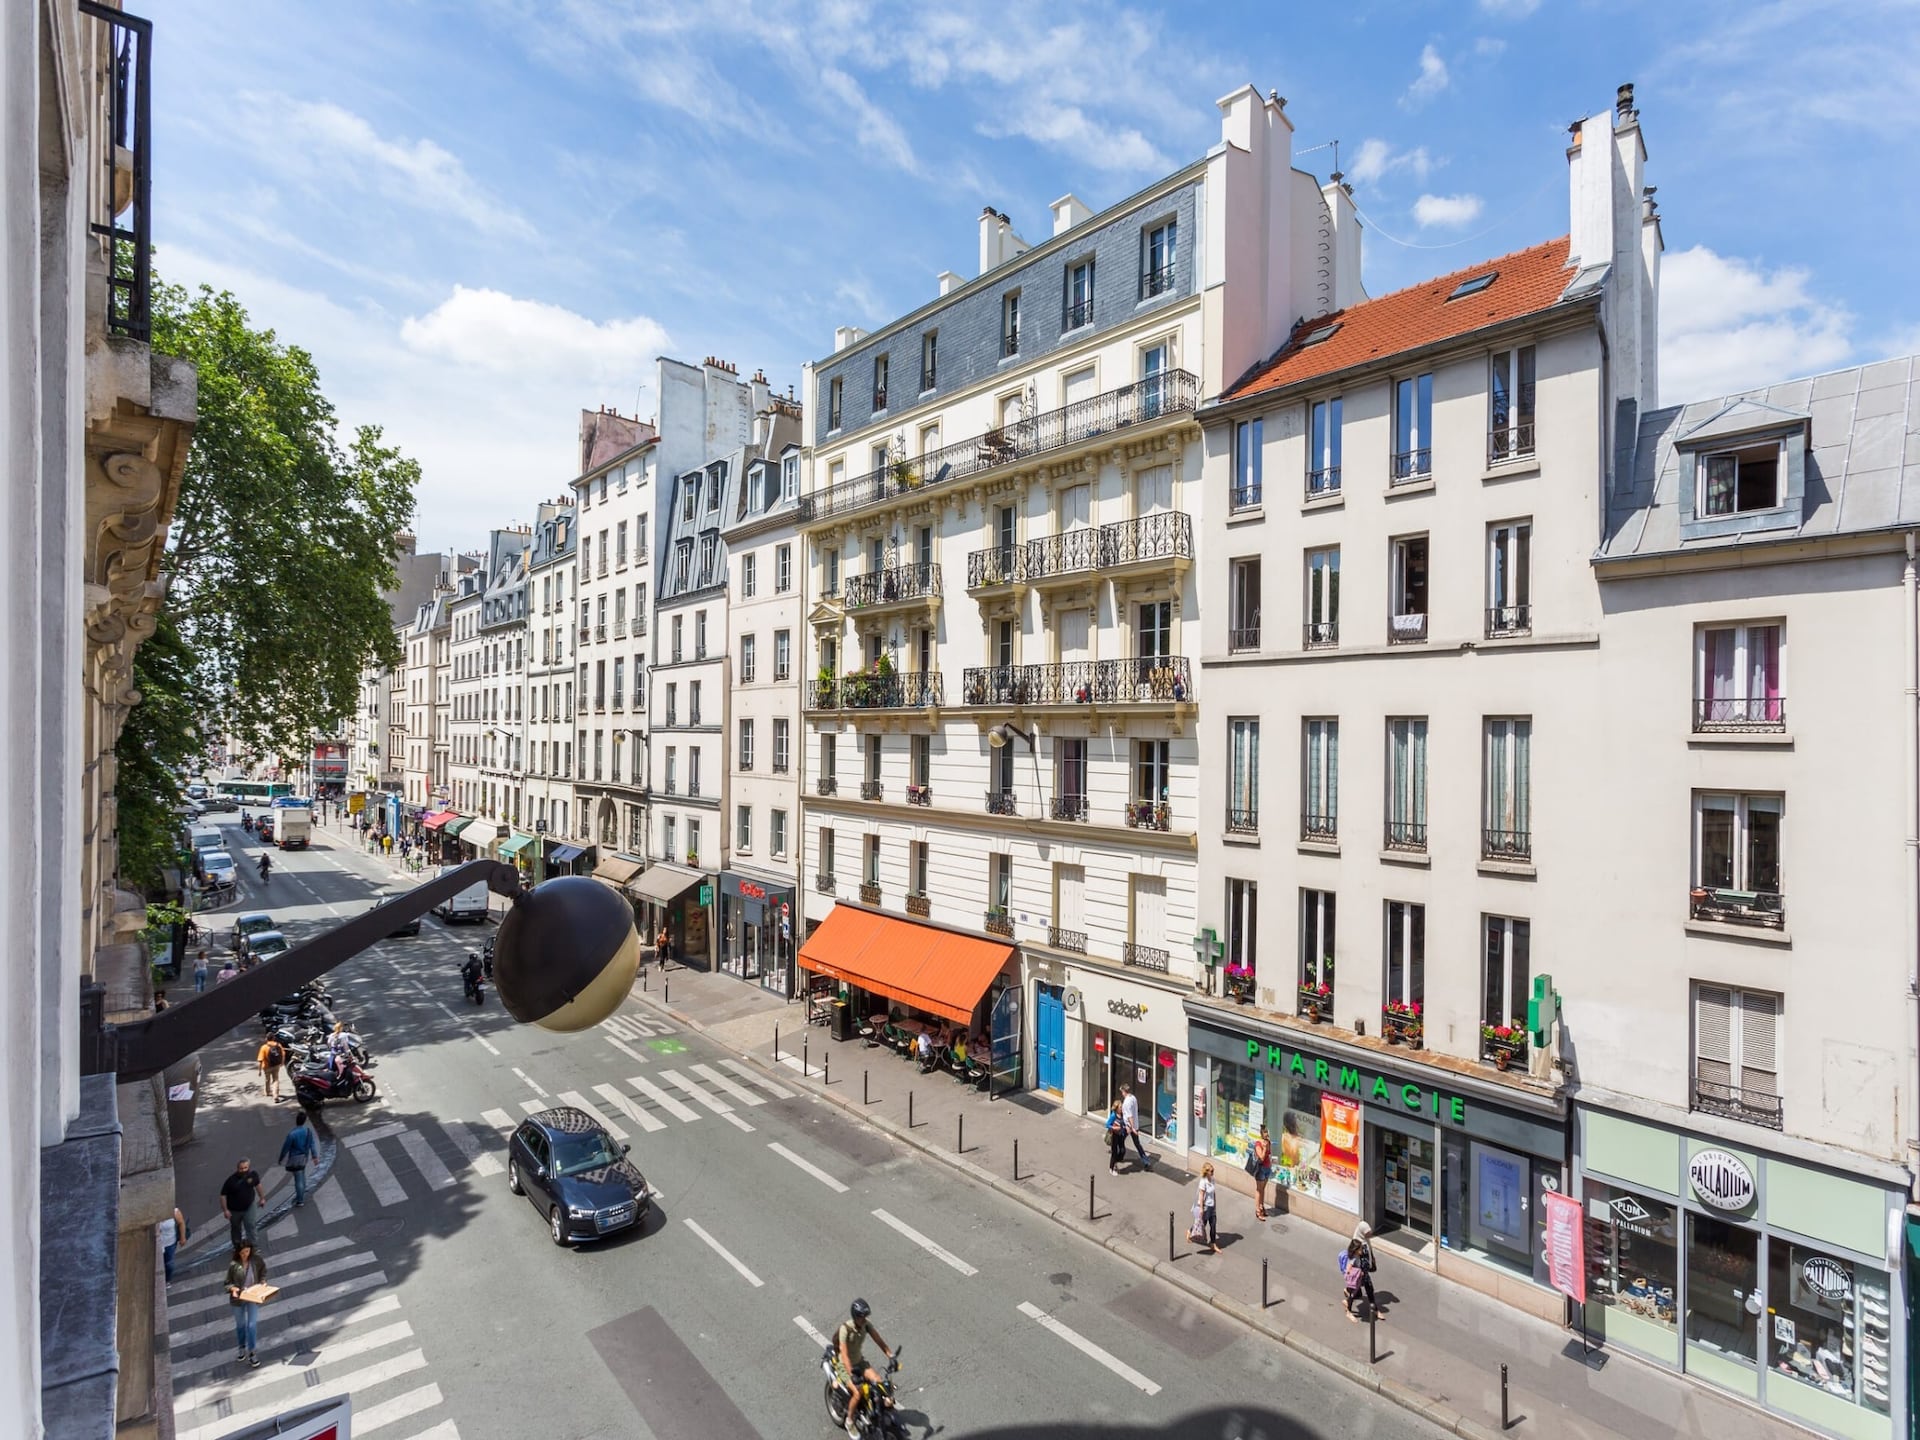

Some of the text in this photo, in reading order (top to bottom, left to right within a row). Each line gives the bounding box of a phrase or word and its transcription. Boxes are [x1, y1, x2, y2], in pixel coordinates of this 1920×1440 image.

[600, 1013, 677, 1041] BUS
[1247, 1039, 1465, 1121] PHARMACIE
[1691, 1164, 1751, 1199] PALLADIUM
[1616, 1218, 1651, 1237] PALLADIUM
[1805, 1267, 1849, 1291] PALLADIUM
